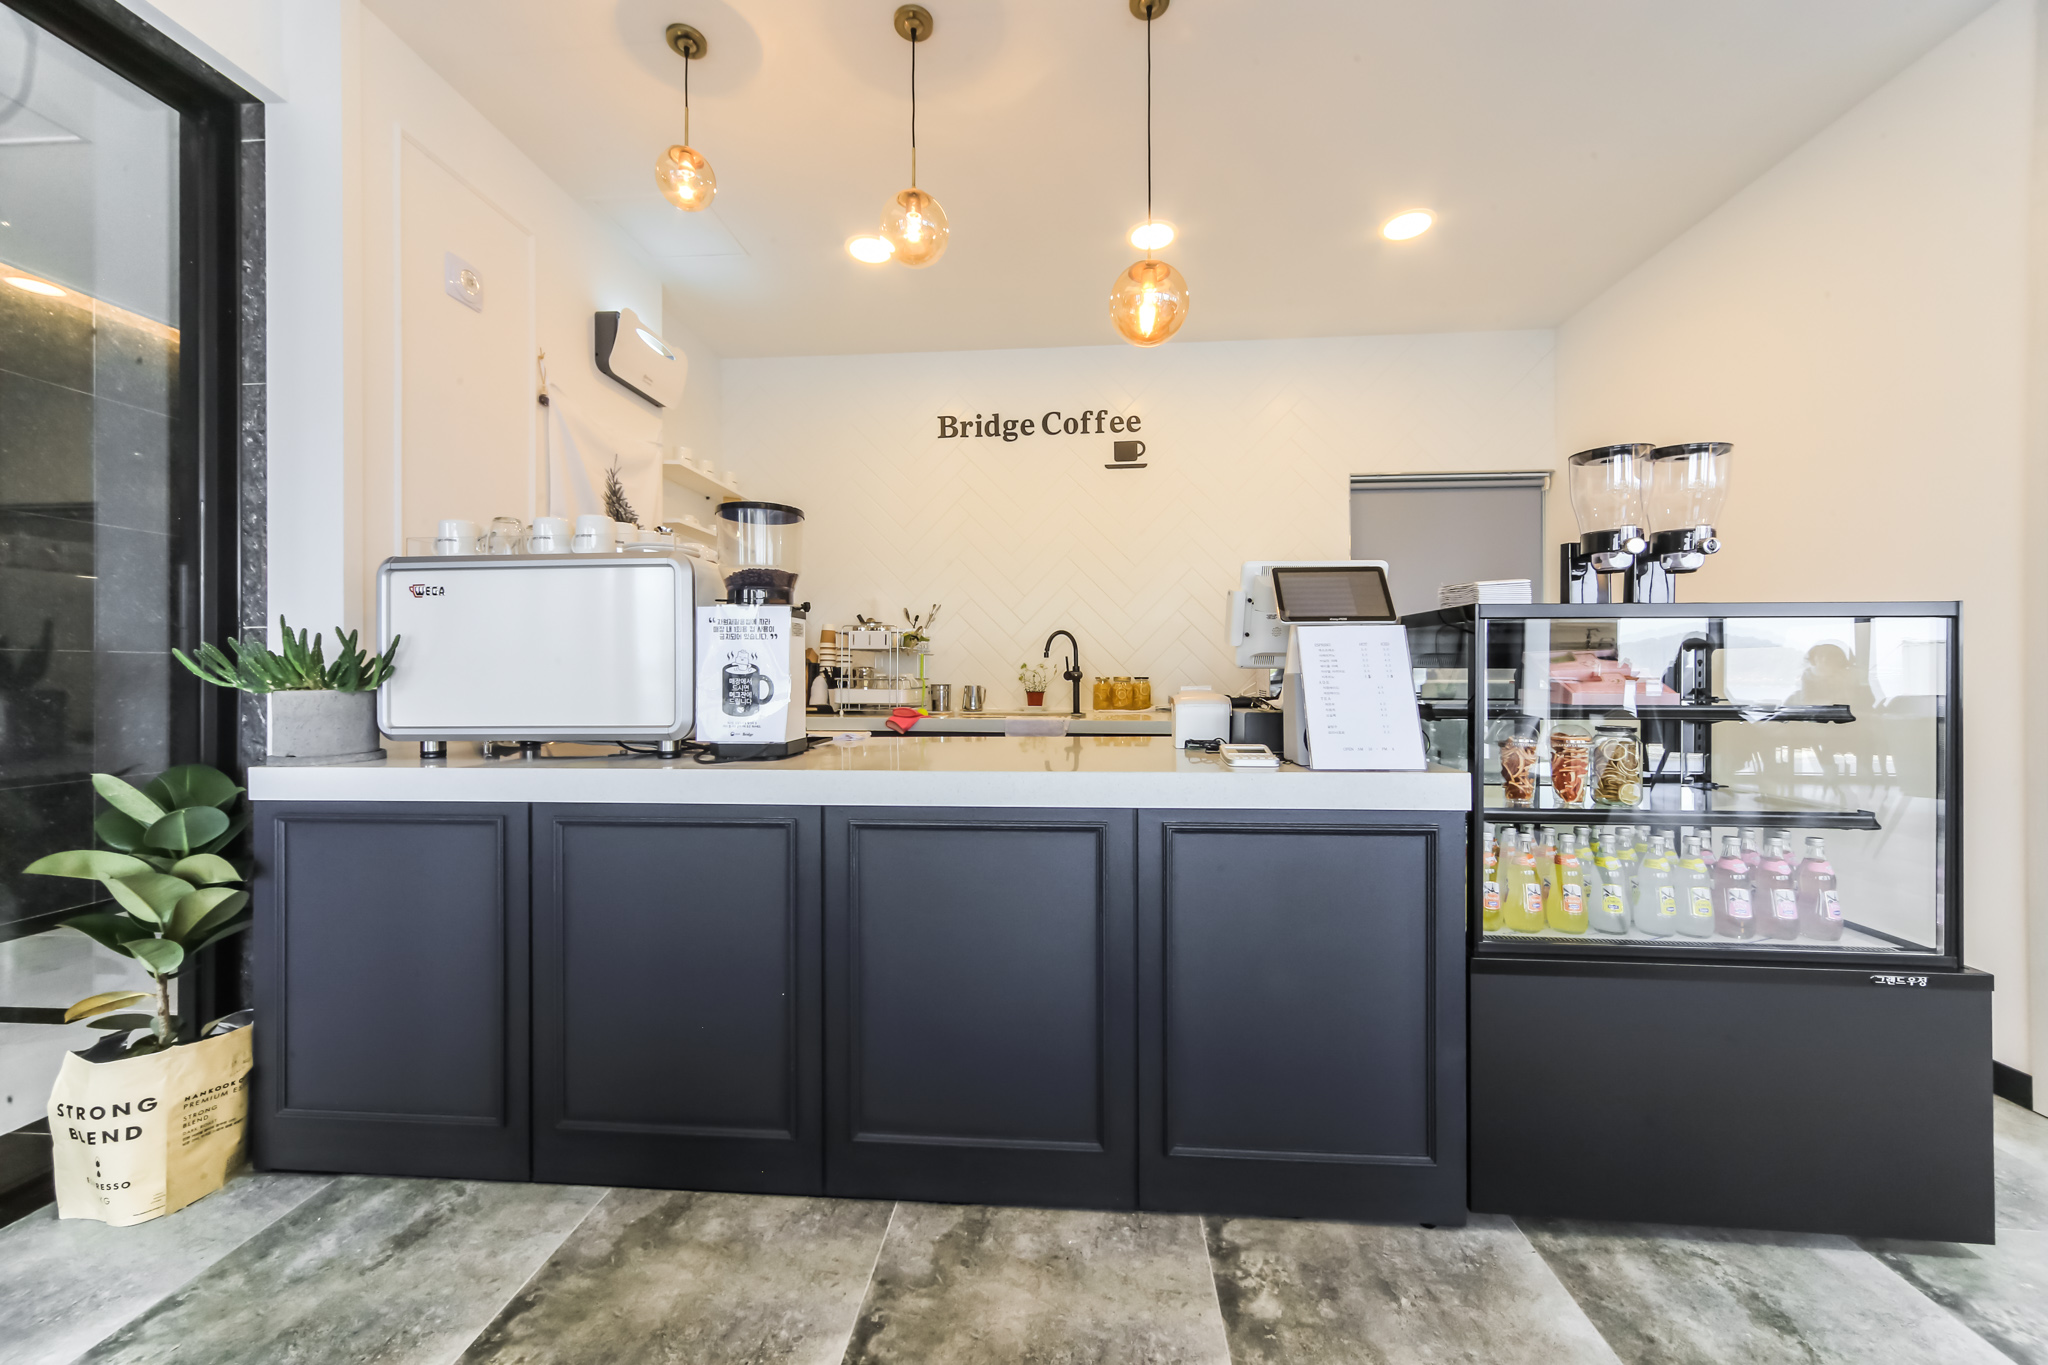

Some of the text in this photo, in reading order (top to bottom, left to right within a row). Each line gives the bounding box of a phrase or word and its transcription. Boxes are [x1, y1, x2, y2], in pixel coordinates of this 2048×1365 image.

[937, 409, 1142, 442] Bridge Coffee
[414, 586, 445, 596] WEGA
[183, 1090, 228, 1110] PREMIUM
[184, 1080, 236, 1102] HANKOOK
[57, 1097, 158, 1120] STRONG
[183, 1105, 218, 1121] STRONG
[182, 1115, 209, 1129] BLEND
[68, 1126, 143, 1145] BLEND
[87, 1177, 131, 1191] RESSO
